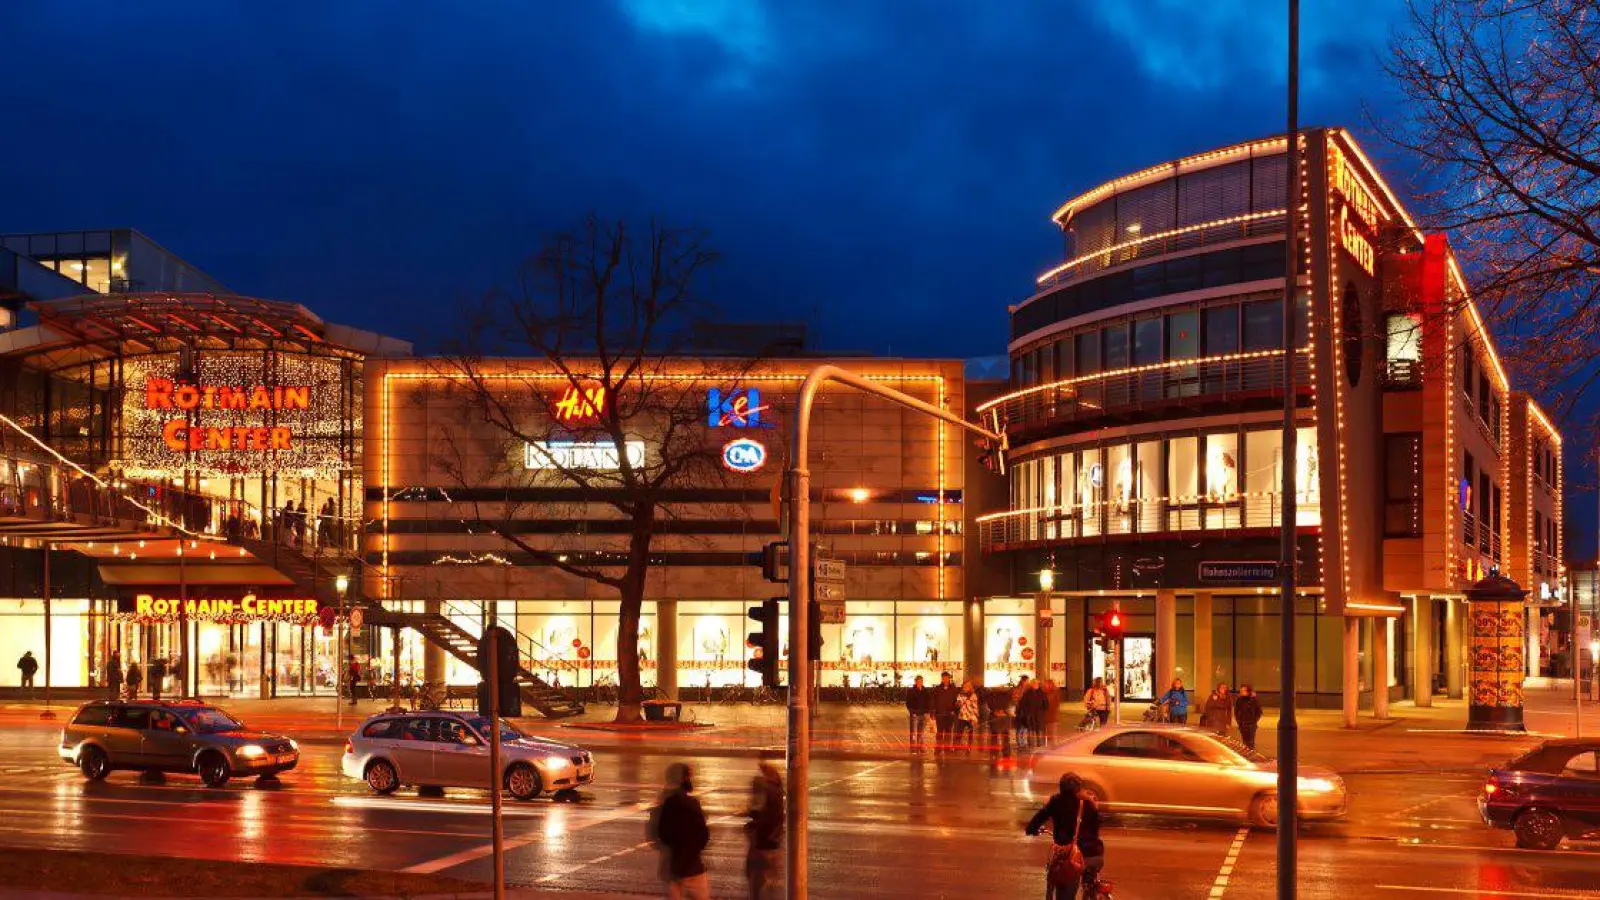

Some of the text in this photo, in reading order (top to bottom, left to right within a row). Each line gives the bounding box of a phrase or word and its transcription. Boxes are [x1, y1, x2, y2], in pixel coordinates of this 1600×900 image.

[146, 377, 310, 410] ROTMAIN
[555, 386, 605, 420] H&M
[162, 419, 292, 451] CENTER
